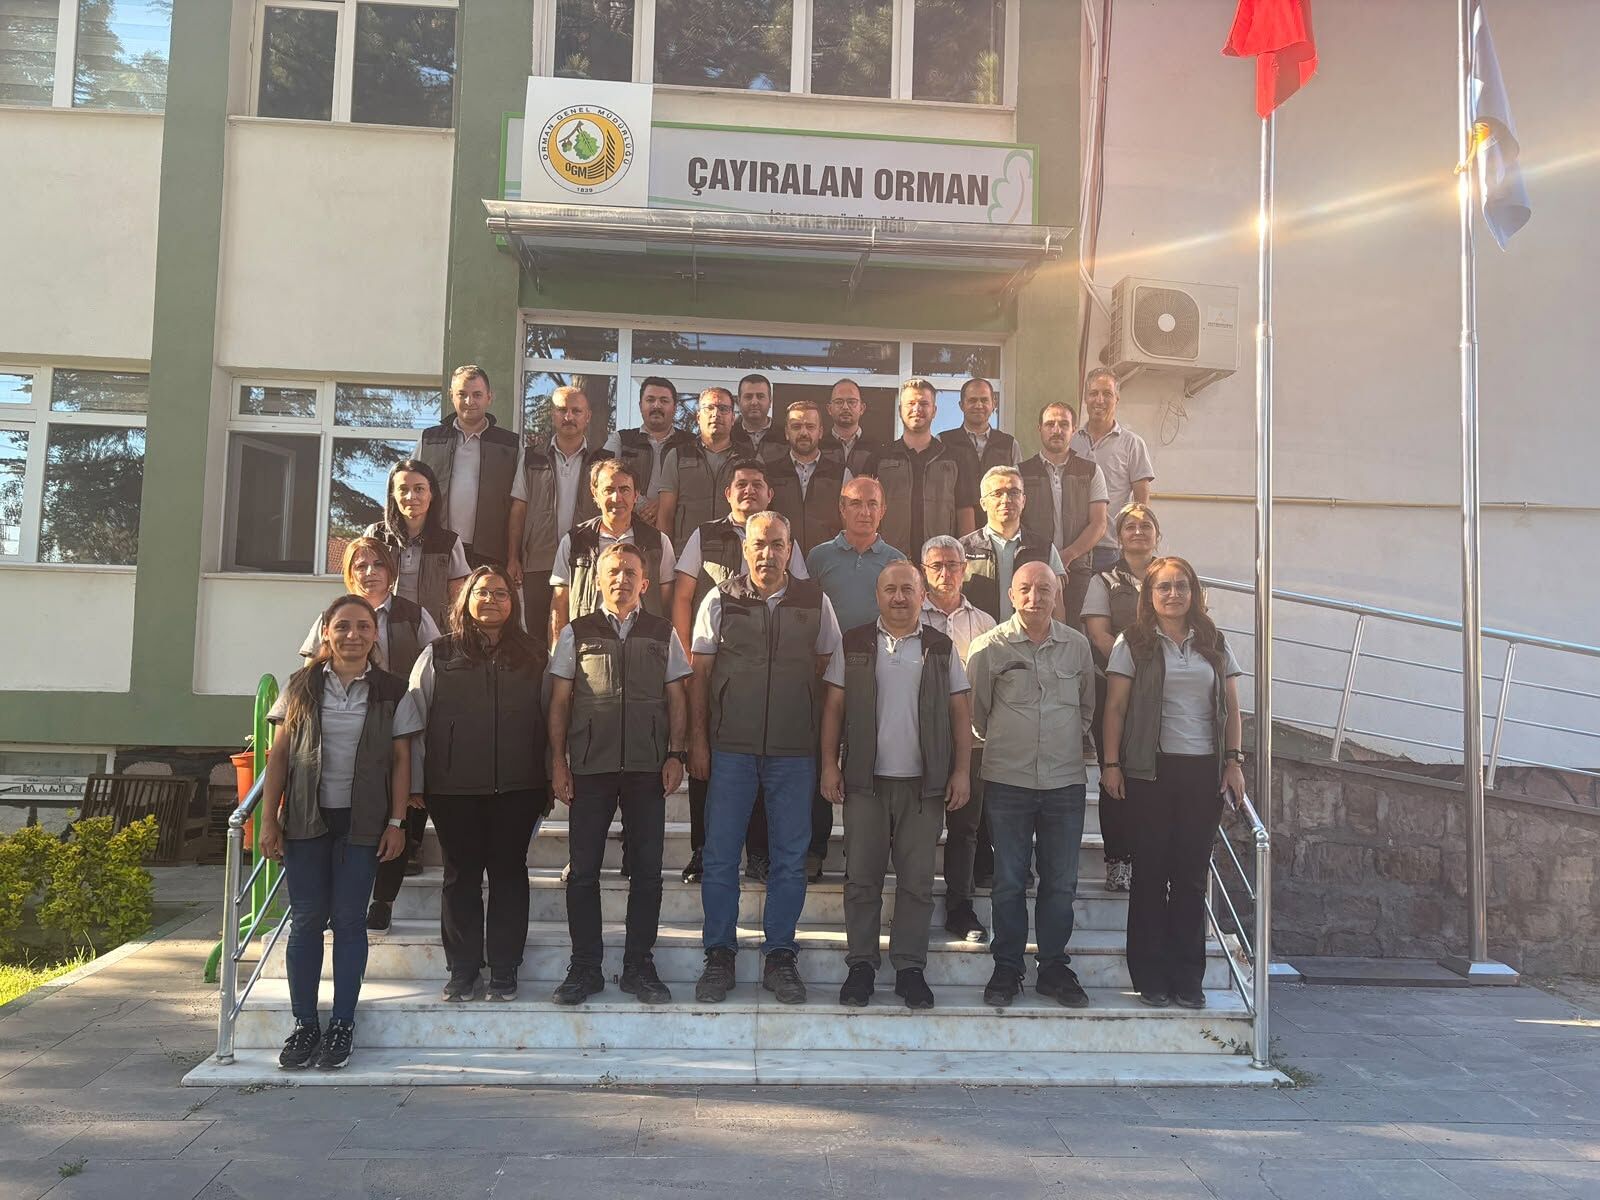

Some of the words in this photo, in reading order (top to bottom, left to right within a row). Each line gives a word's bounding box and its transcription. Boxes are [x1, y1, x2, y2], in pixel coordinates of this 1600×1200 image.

[541, 123, 554, 160] ORMAN
[556, 107, 591, 121] GENEL
[565, 162, 587, 179] OGM
[687, 156, 863, 199] ÇAYIRALAN
[874, 168, 989, 206] ORMAN
